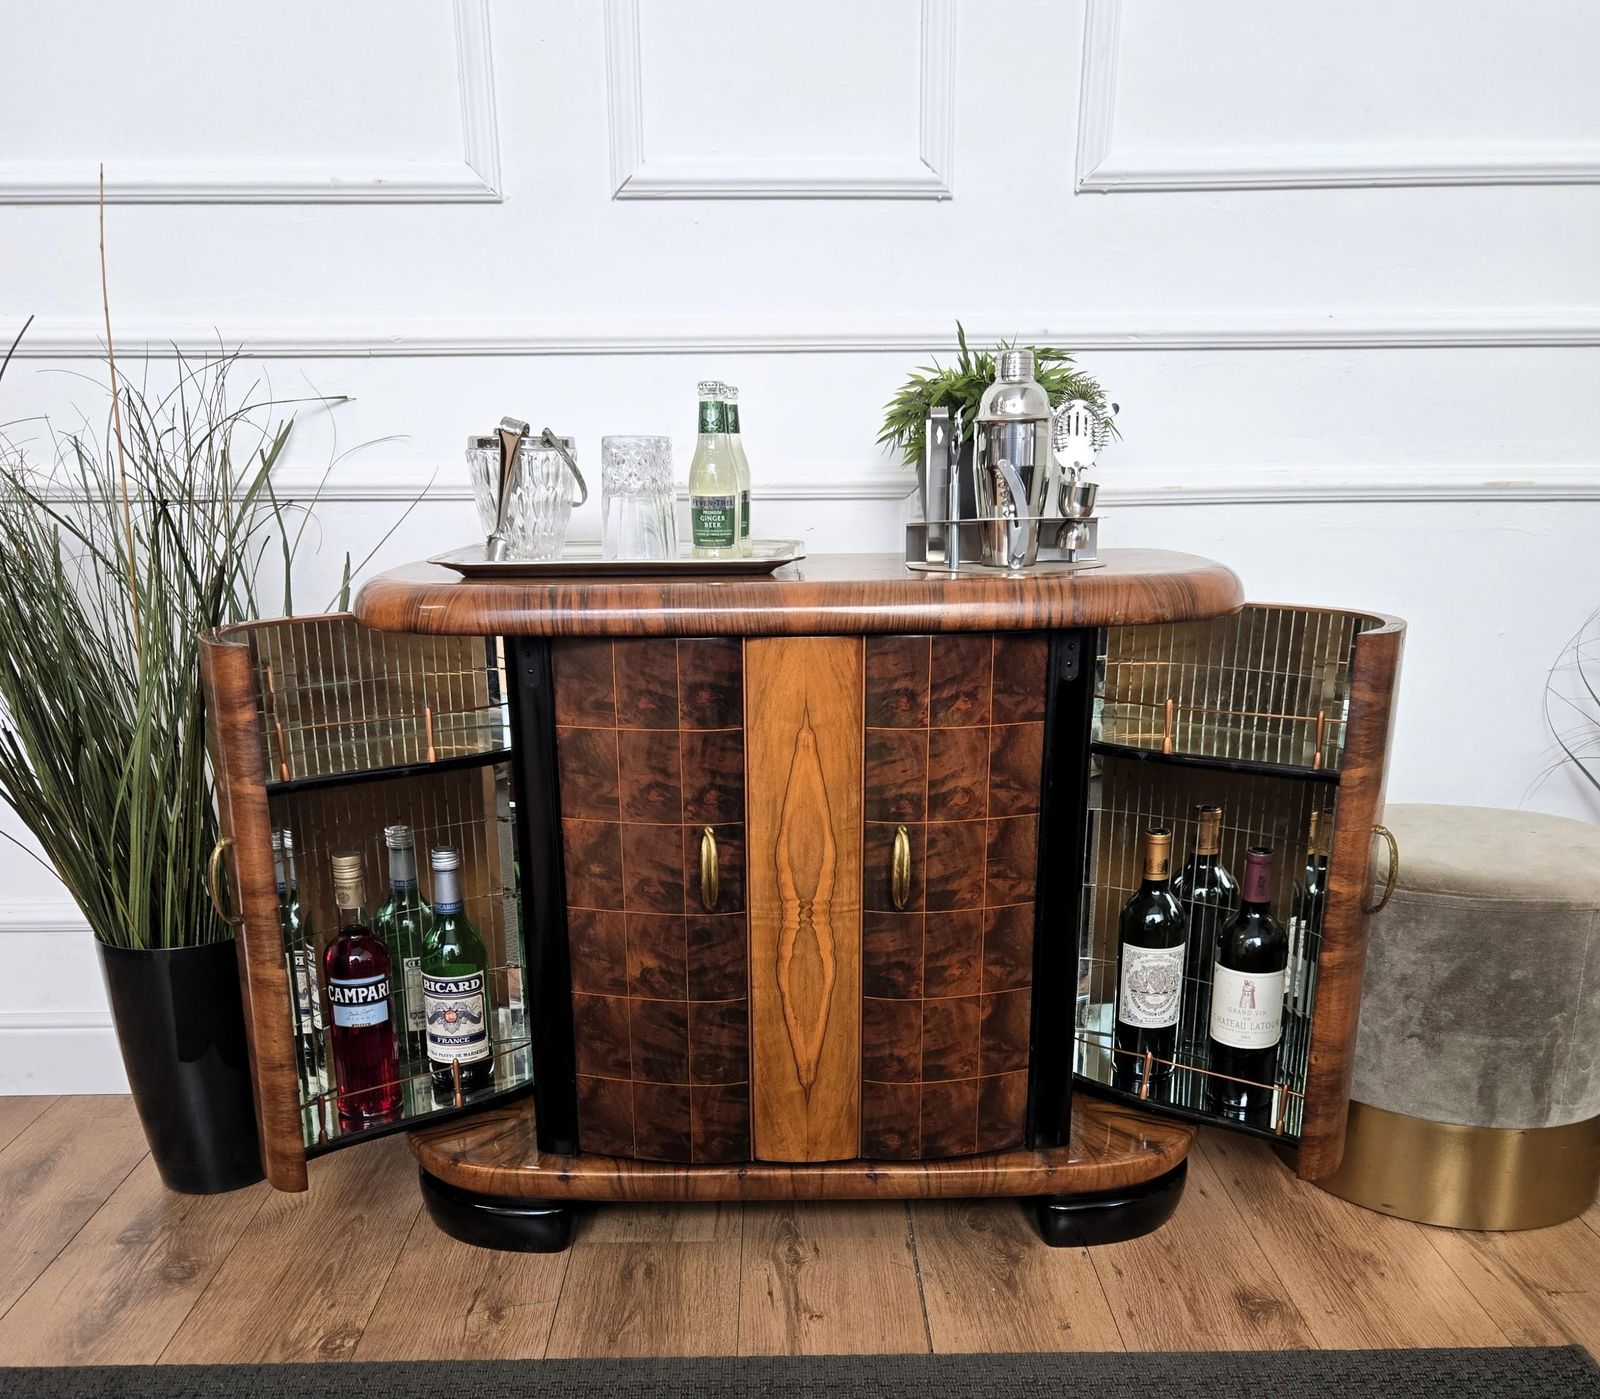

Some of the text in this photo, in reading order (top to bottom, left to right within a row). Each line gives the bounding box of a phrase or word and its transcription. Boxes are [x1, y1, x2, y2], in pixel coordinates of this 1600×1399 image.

[328, 980, 390, 1004] CAMPARI
[423, 978, 480, 993] RICARD
[1227, 1006, 1267, 1017] GRAND VIN
[1250, 1017, 1280, 1031] LATOUR
[437, 1036, 470, 1045] FRANCE
